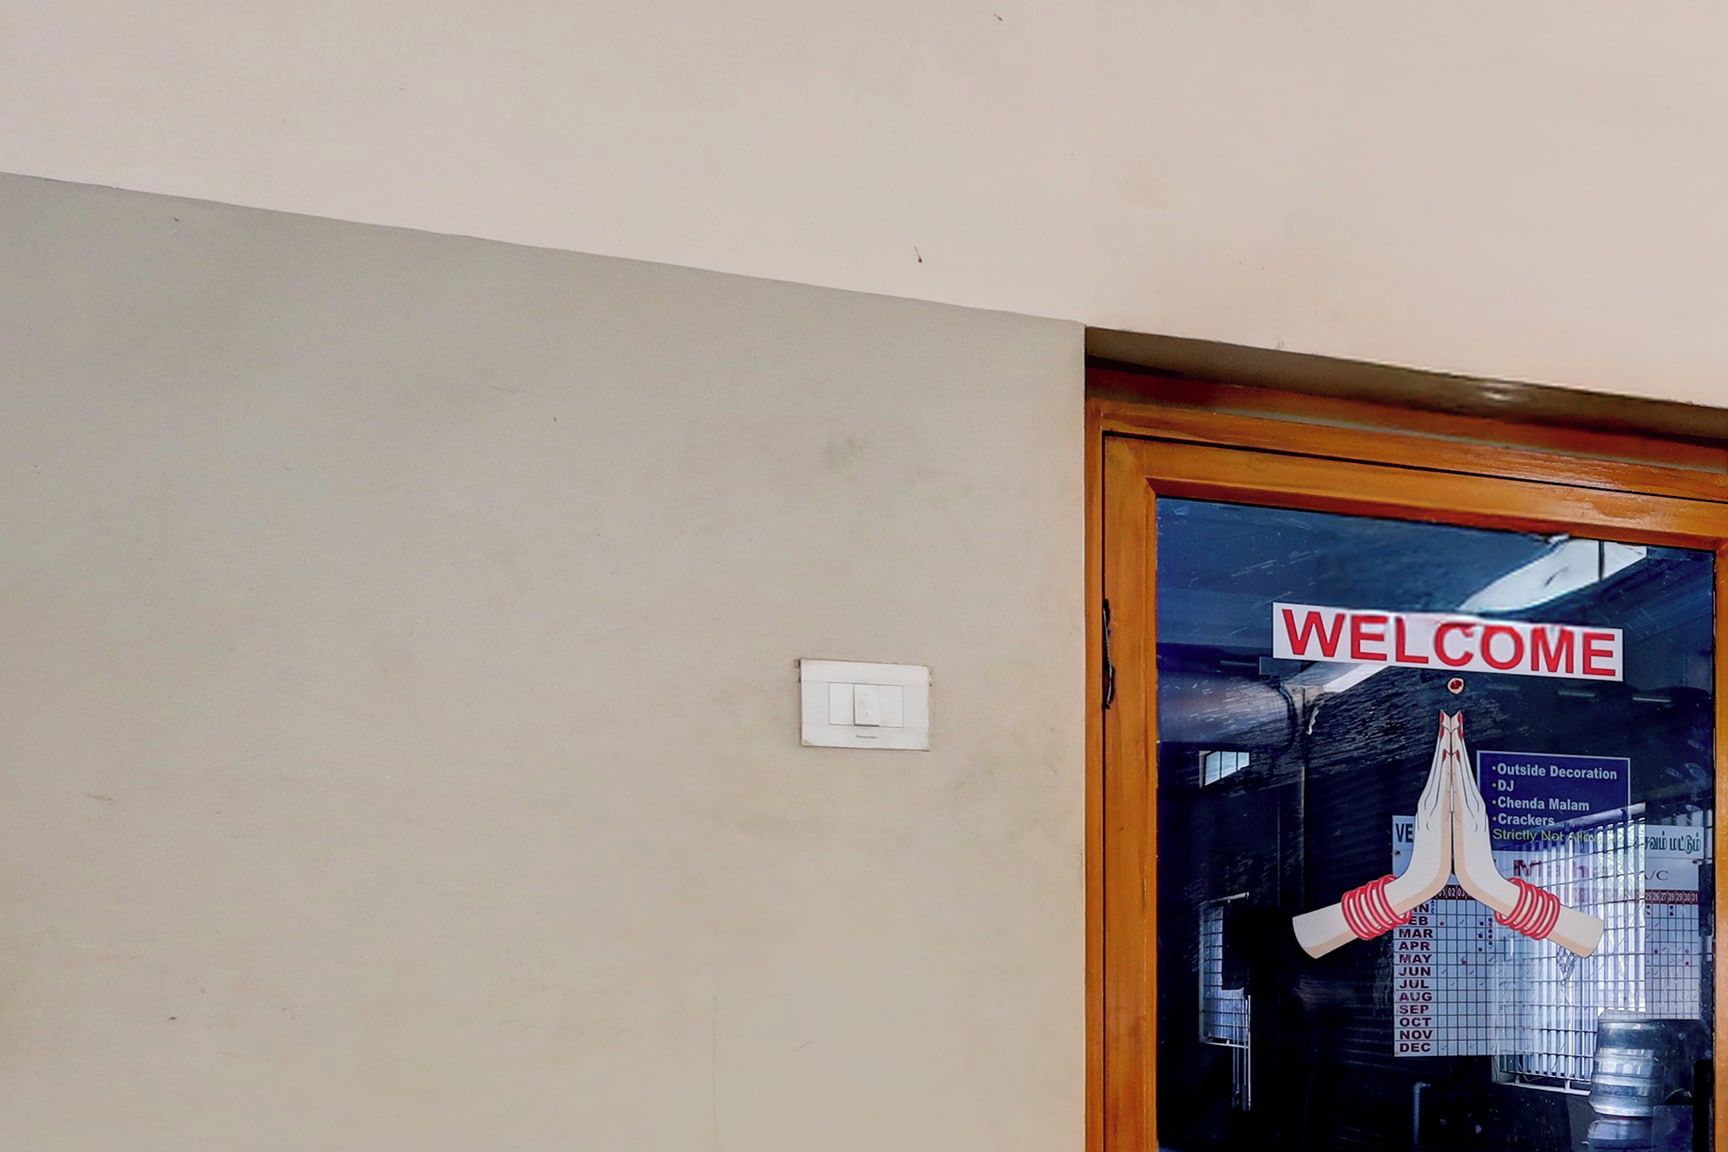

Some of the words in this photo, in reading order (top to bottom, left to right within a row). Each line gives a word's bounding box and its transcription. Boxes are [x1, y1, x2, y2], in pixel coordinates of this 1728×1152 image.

[1281, 608, 1617, 677] WELCOME
[1497, 762, 1546, 777] Outside
[1550, 765, 1618, 780] Decoration
[1497, 779, 1514, 792] DJ
[1497, 796, 1545, 810] Chenda
[1548, 798, 1590, 812] Malam
[1497, 813, 1555, 826] Crackers
[1492, 828, 1538, 842] Strictly
[1541, 829, 1564, 842] Not
[1408, 915, 1429, 926] EB
[1399, 928, 1433, 939] MAR
[1399, 941, 1431, 951] APR
[1399, 954, 1432, 964] MAY
[1399, 967, 1431, 976] JUN
[1399, 980, 1430, 989] JUL
[1399, 992, 1433, 1002] AUG
[1399, 1004, 1429, 1014] SEP
[1399, 1017, 1432, 1027] OCT
[1400, 1029, 1433, 1040] NOV
[1400, 1042, 1431, 1053] DEC
